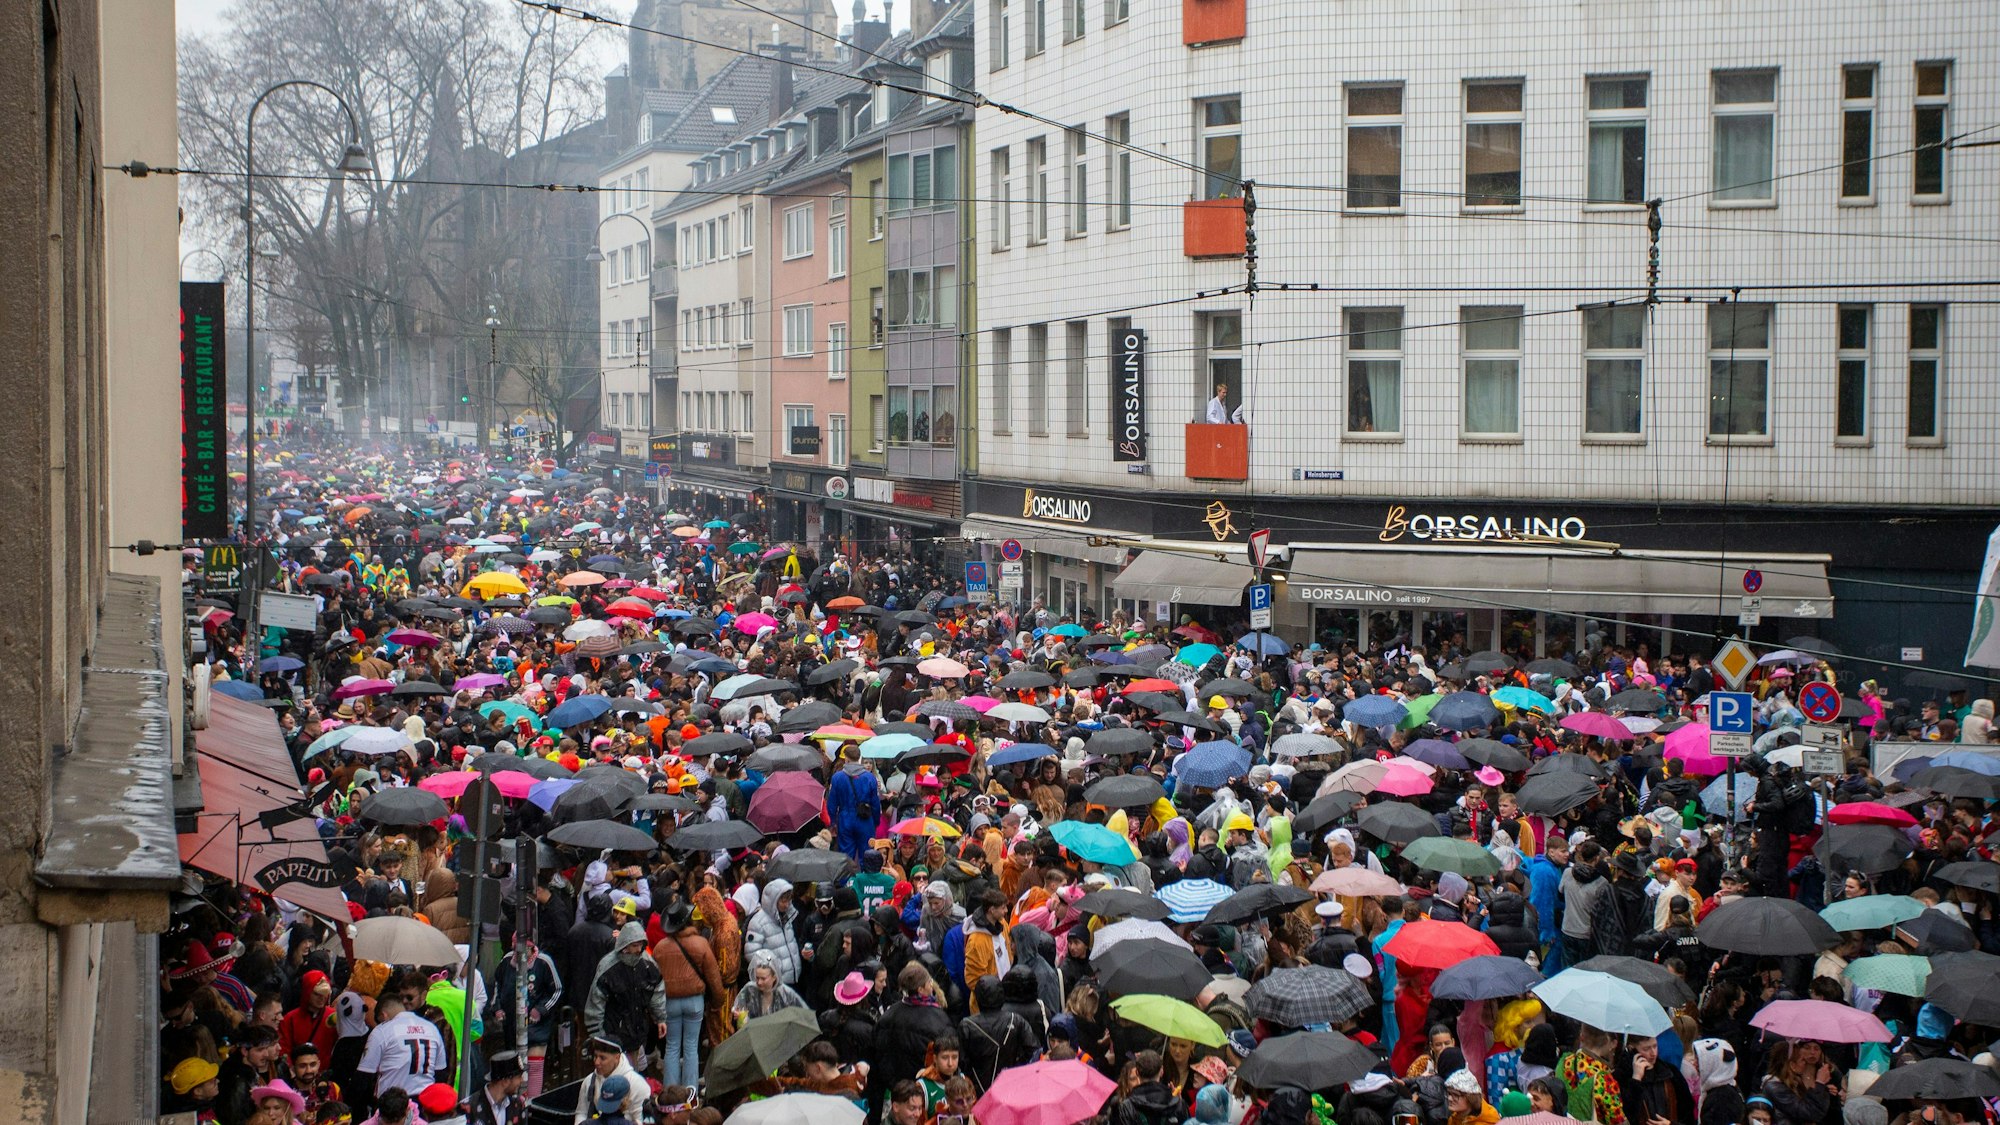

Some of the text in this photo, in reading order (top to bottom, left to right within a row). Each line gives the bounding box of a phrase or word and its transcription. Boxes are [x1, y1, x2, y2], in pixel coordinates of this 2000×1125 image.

[1120, 335, 1140, 458] BORSALINO
[193, 314, 216, 513] CAFÉ BAR RESTAURANT
[1023, 488, 1091, 522] BORSALINO
[1379, 505, 1586, 542] BORSALINO
[968, 583, 986, 591] TAXI
[1255, 588, 1267, 607] P
[1301, 588, 1393, 602] BORSALINO
[1412, 596, 1431, 604] 1987
[1716, 697, 1740, 727] P
[863, 885, 885, 895] MARINO
[404, 1038, 430, 1075] 11
